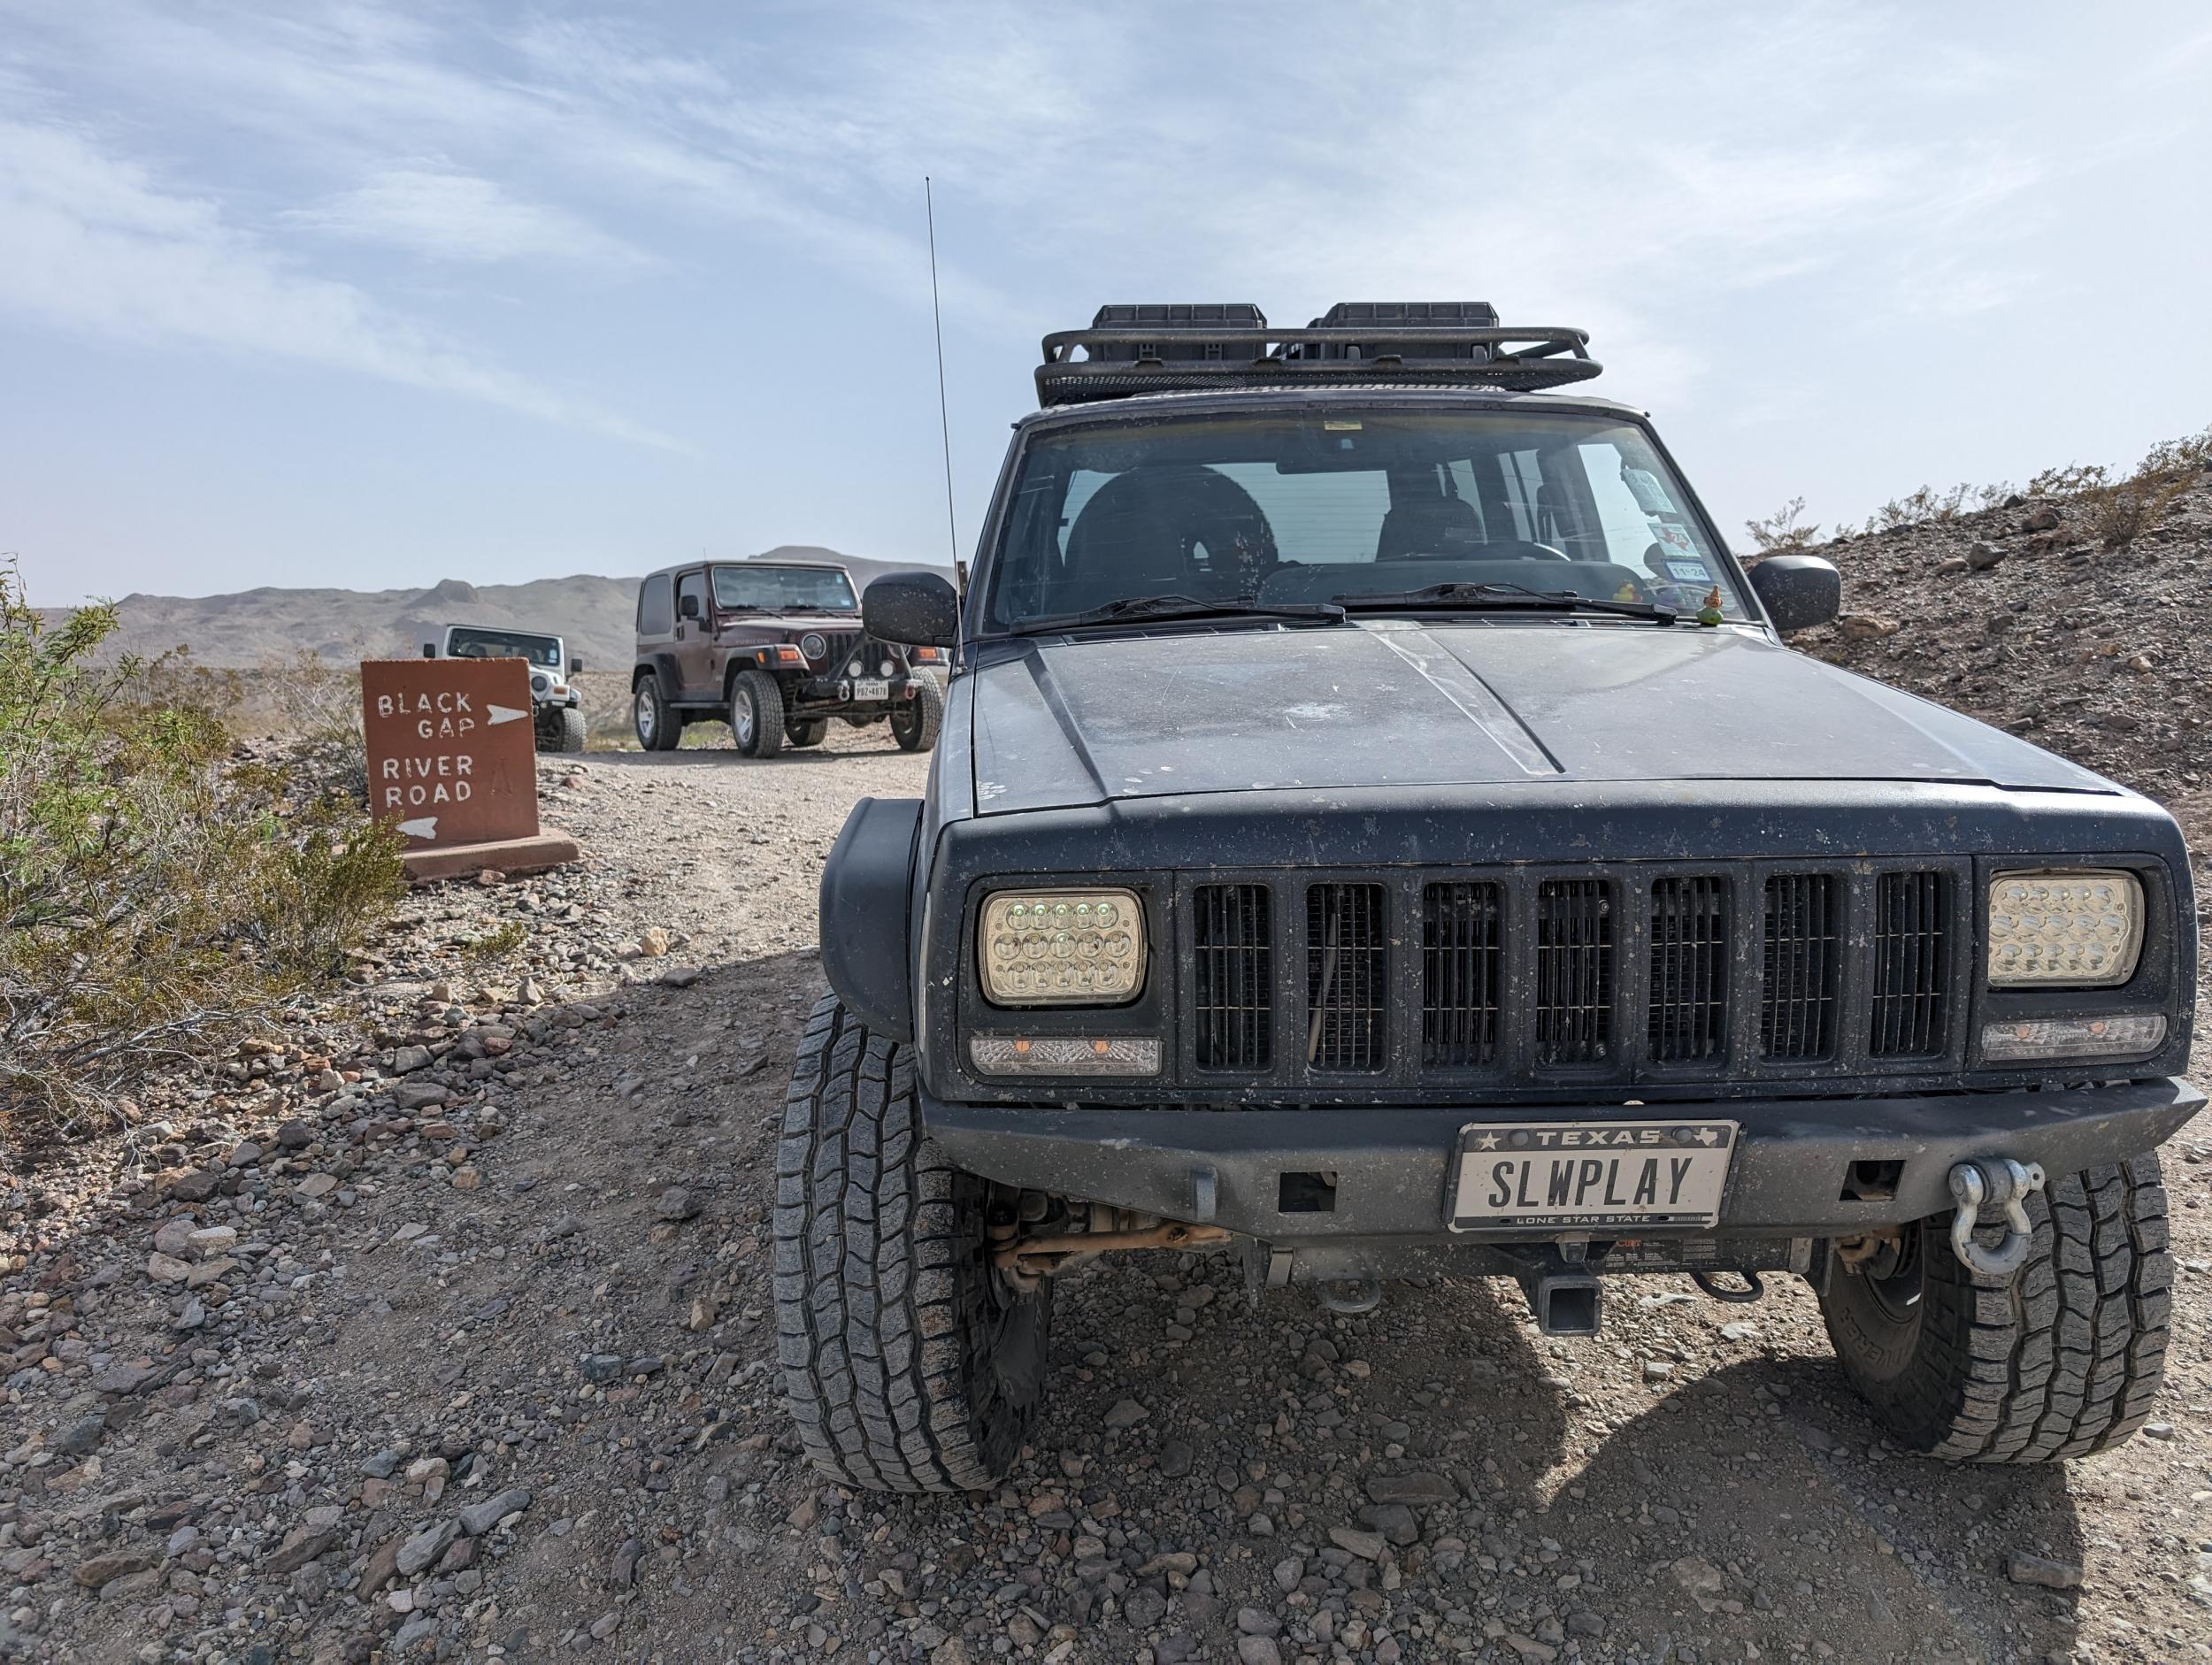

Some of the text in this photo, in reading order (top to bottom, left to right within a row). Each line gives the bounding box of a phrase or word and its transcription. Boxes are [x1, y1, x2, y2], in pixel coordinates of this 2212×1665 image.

[378, 692, 472, 717] BLACK
[418, 717, 475, 739] GAP
[382, 755, 473, 779] RIVER
[385, 780, 472, 808] ROAD
[1536, 1129, 1661, 1146] TEXAS
[1487, 1156, 1694, 1208] SLWPLAY
